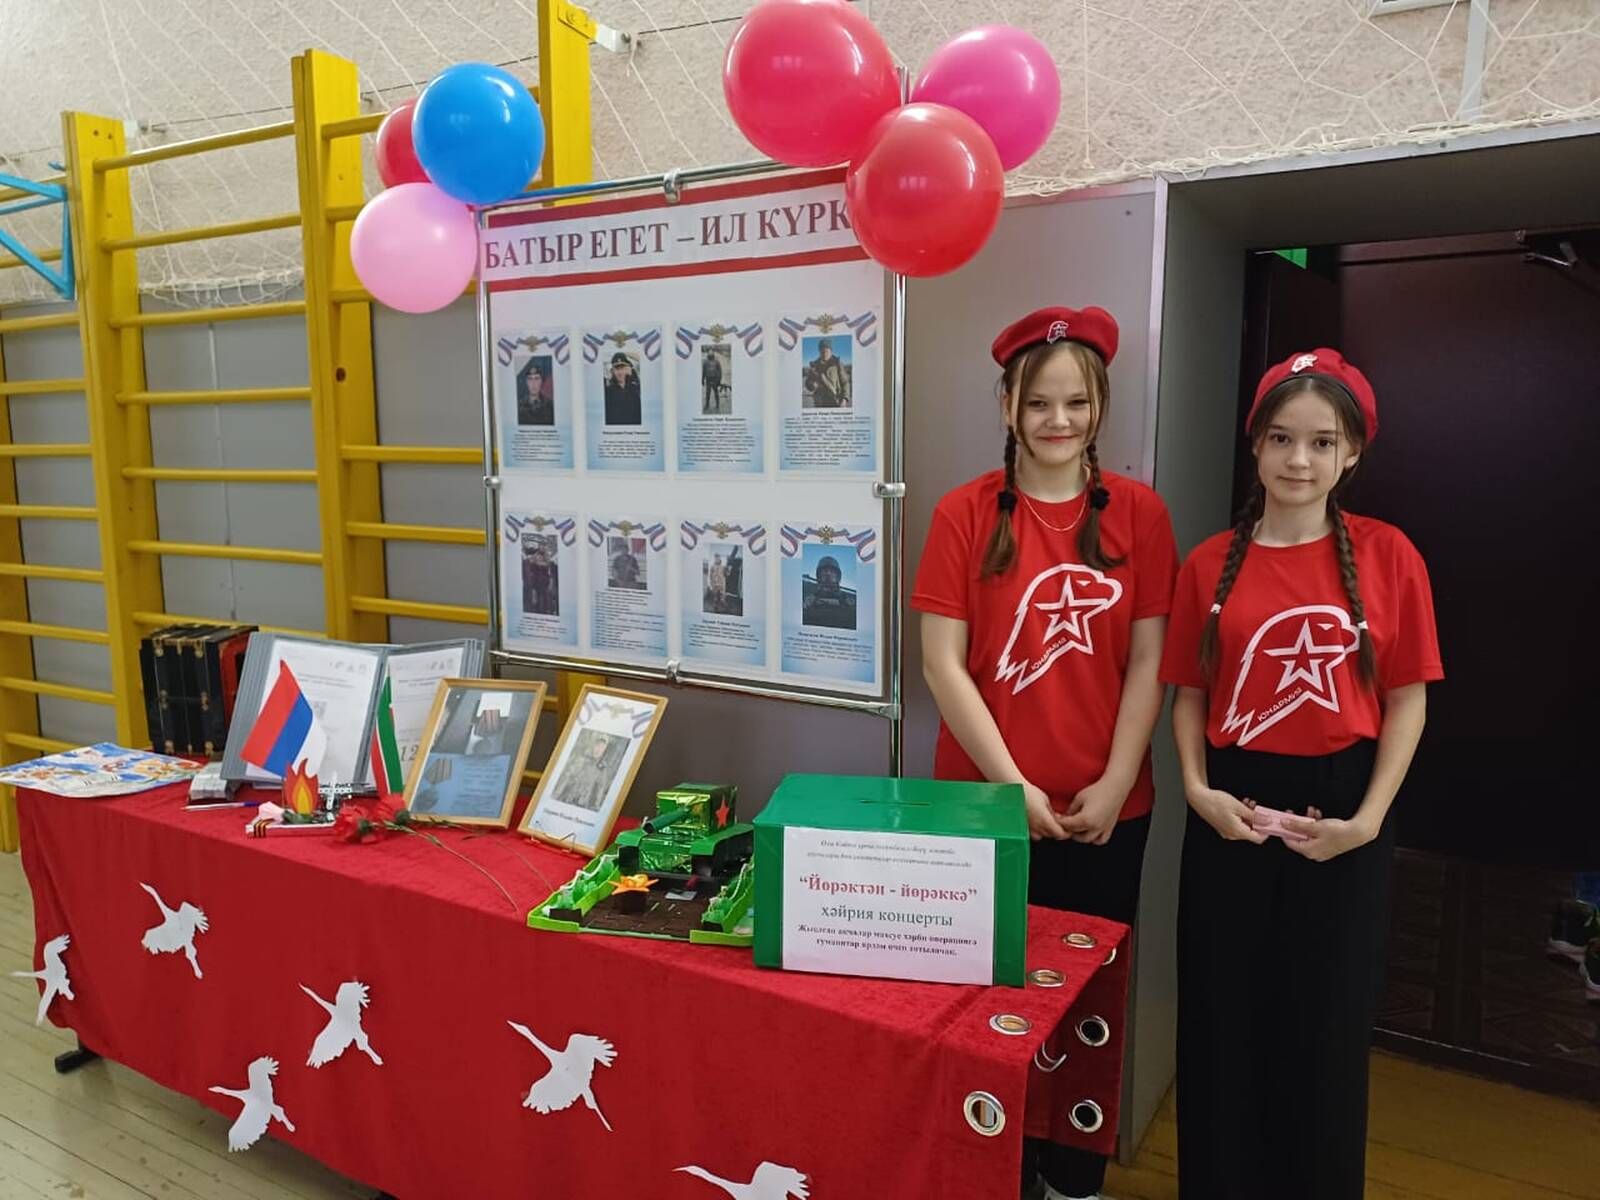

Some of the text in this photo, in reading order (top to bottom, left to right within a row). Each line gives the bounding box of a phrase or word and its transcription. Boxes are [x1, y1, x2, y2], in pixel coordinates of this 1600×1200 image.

[484, 232, 583, 269] БАТЫР
[590, 223, 670, 259] ЕГЕТ
[699, 212, 748, 246] ИЛ
[757, 199, 852, 241] КҮРК
[821, 904, 953, 928] хәйрия концерты
